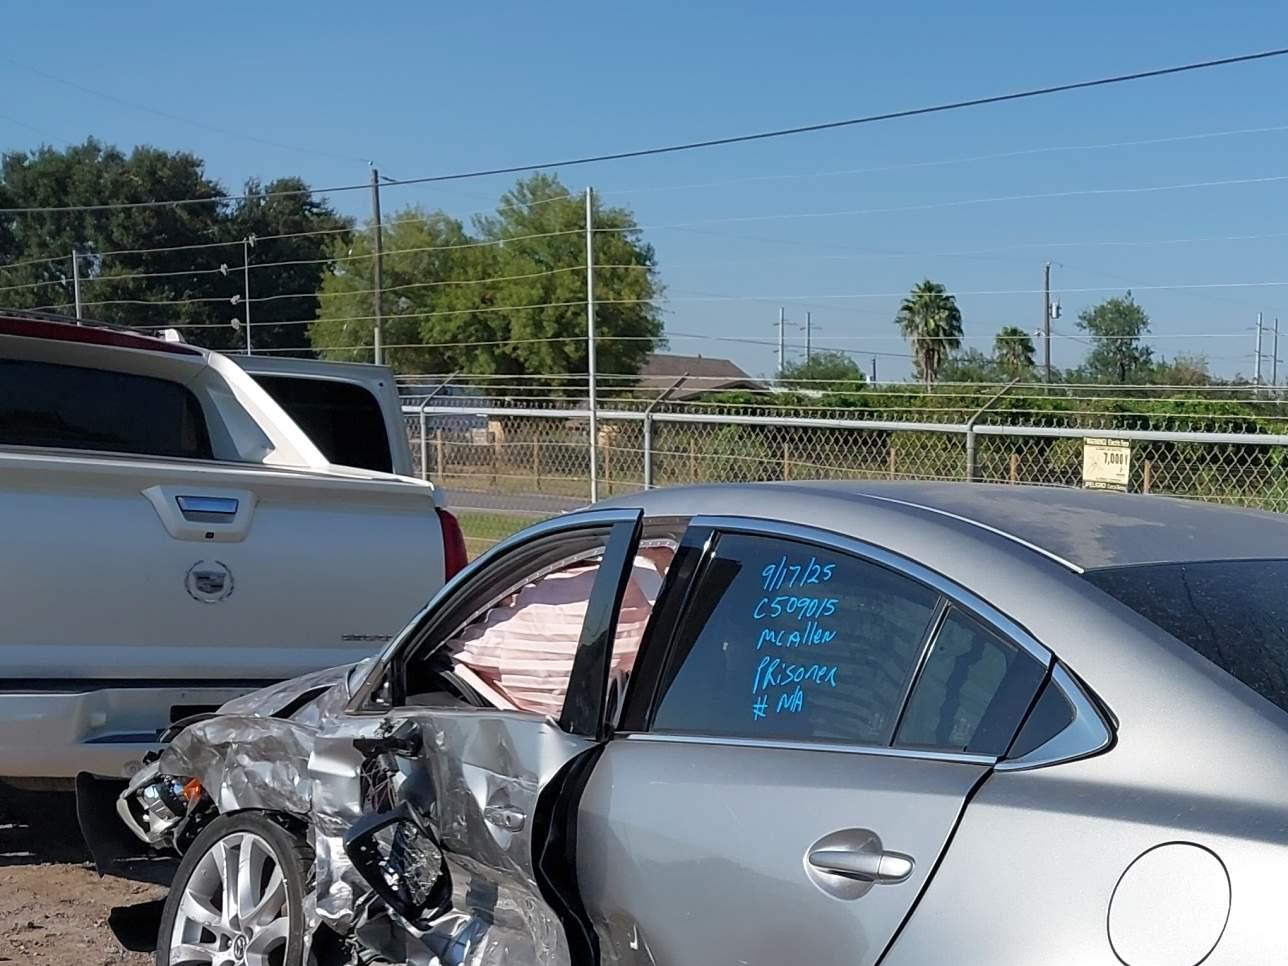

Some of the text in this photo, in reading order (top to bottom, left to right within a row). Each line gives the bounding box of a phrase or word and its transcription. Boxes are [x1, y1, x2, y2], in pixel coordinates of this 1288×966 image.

[762, 556, 836, 591] 9/17/25
[753, 596, 838, 620] C509015
[752, 686, 803, 720] # N/A
